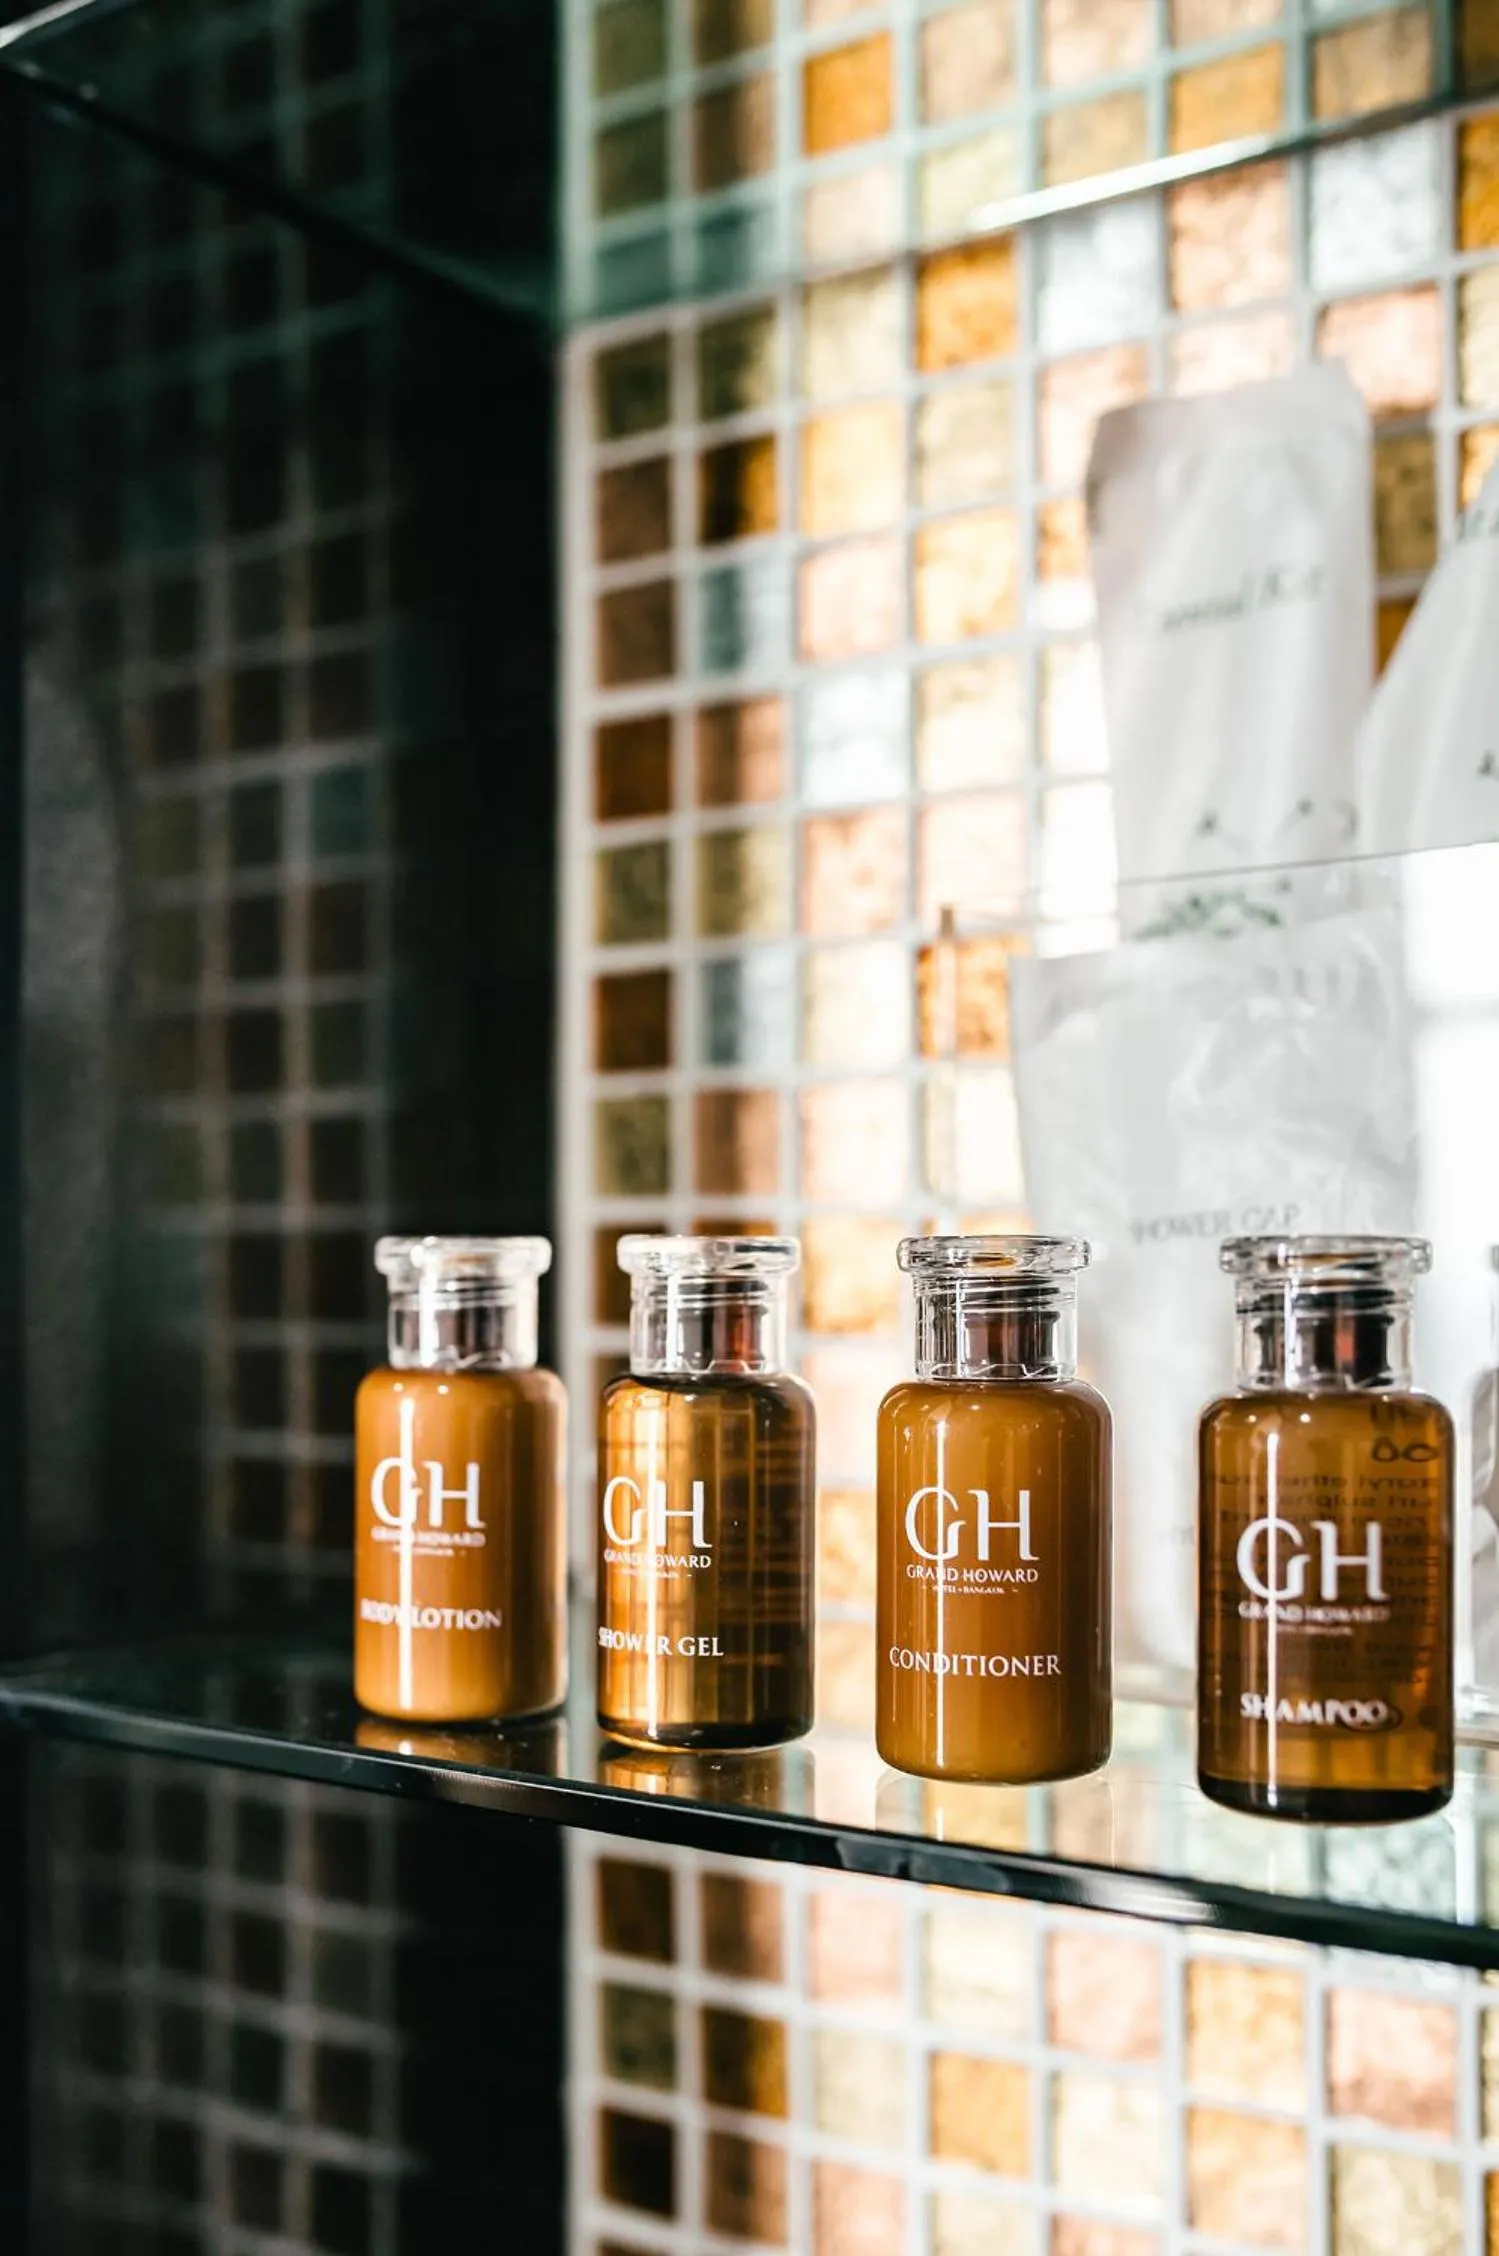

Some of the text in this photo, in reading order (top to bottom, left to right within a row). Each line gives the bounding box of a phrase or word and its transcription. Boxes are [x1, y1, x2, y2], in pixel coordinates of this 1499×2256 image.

[370, 1457, 487, 1528] GH
[603, 1476, 713, 1548] GH
[905, 1486, 1040, 1561] GH
[650, 1553, 712, 1569] OWARD
[963, 1567, 1039, 1584] HOWARD
[1236, 1517, 1392, 1601] GH
[411, 1606, 502, 1632] LOTION
[677, 1636, 724, 1657] GEL
[889, 1645, 1062, 1678] CONDITIONER
[1240, 1691, 1389, 1727] SHAMPOO
